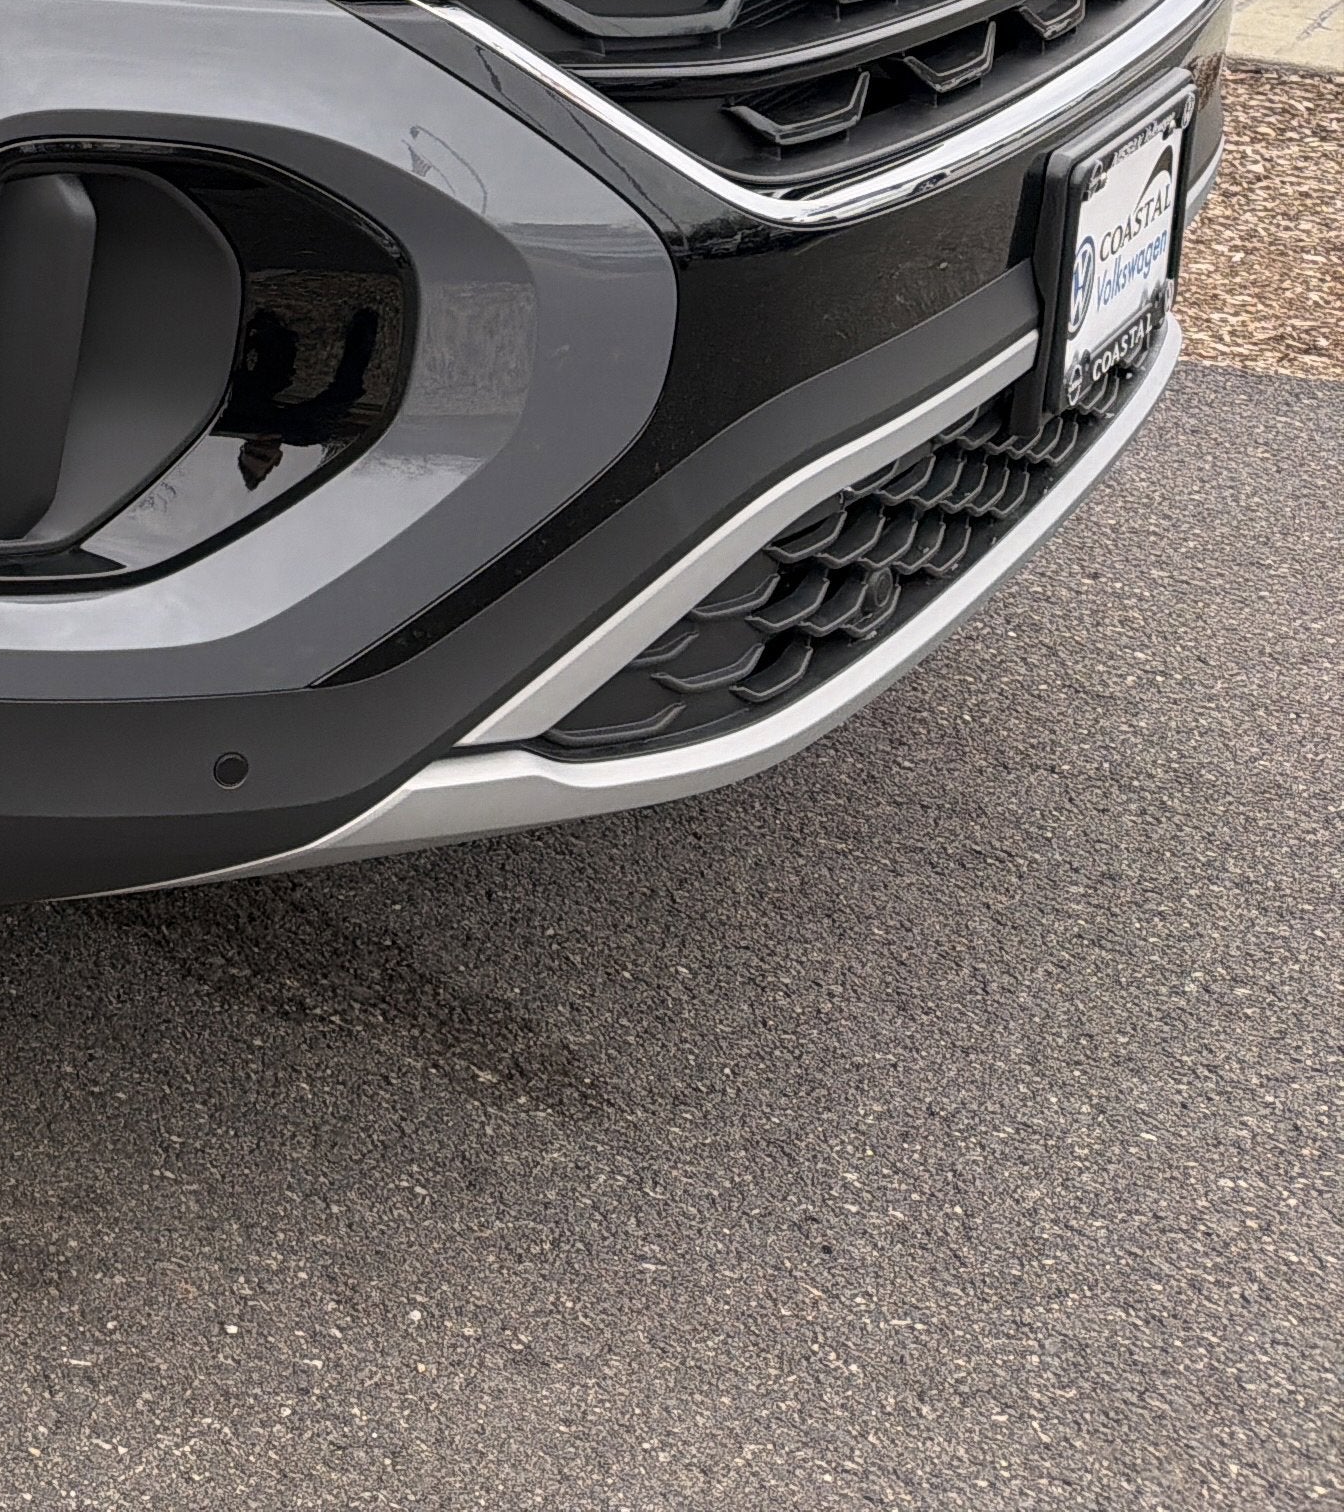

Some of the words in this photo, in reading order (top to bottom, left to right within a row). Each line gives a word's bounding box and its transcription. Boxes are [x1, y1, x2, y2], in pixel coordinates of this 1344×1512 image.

[1100, 182, 1172, 261] COASTAL
[1095, 229, 1168, 313] Volkswagen
[1091, 312, 1153, 382] COASTAL
